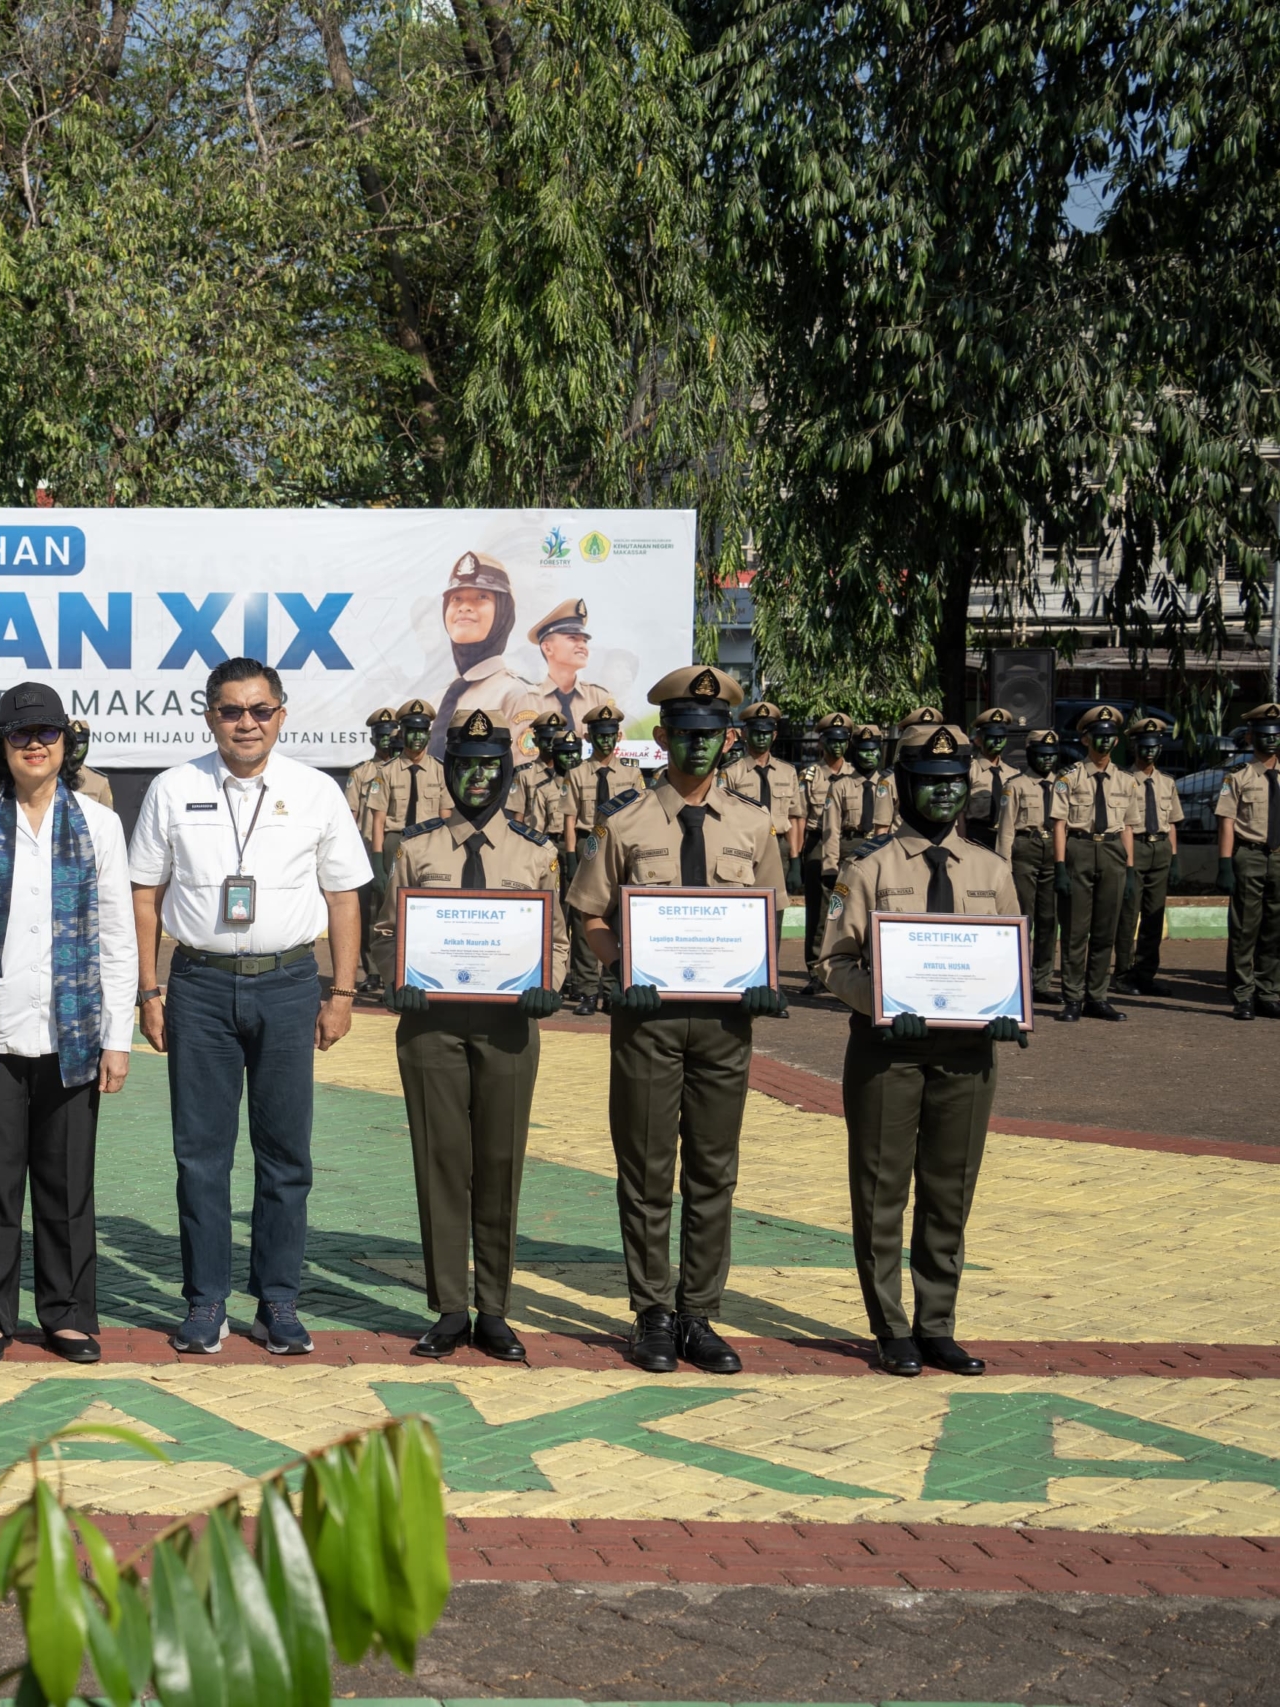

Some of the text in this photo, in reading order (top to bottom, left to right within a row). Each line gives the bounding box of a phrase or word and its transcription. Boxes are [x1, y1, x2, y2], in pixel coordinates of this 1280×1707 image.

[157, 592, 355, 670] XIX
[144, 731, 195, 744] HIJAU
[436, 909, 506, 920] SERTIFIKAT
[658, 905, 728, 916] SERTIFIKAT
[443, 938, 464, 946] Arikah
[466, 938, 489, 946] Naurah
[908, 931, 979, 943] SERTIFIKAT
[923, 962, 971, 971] AYATUL HUSNA
